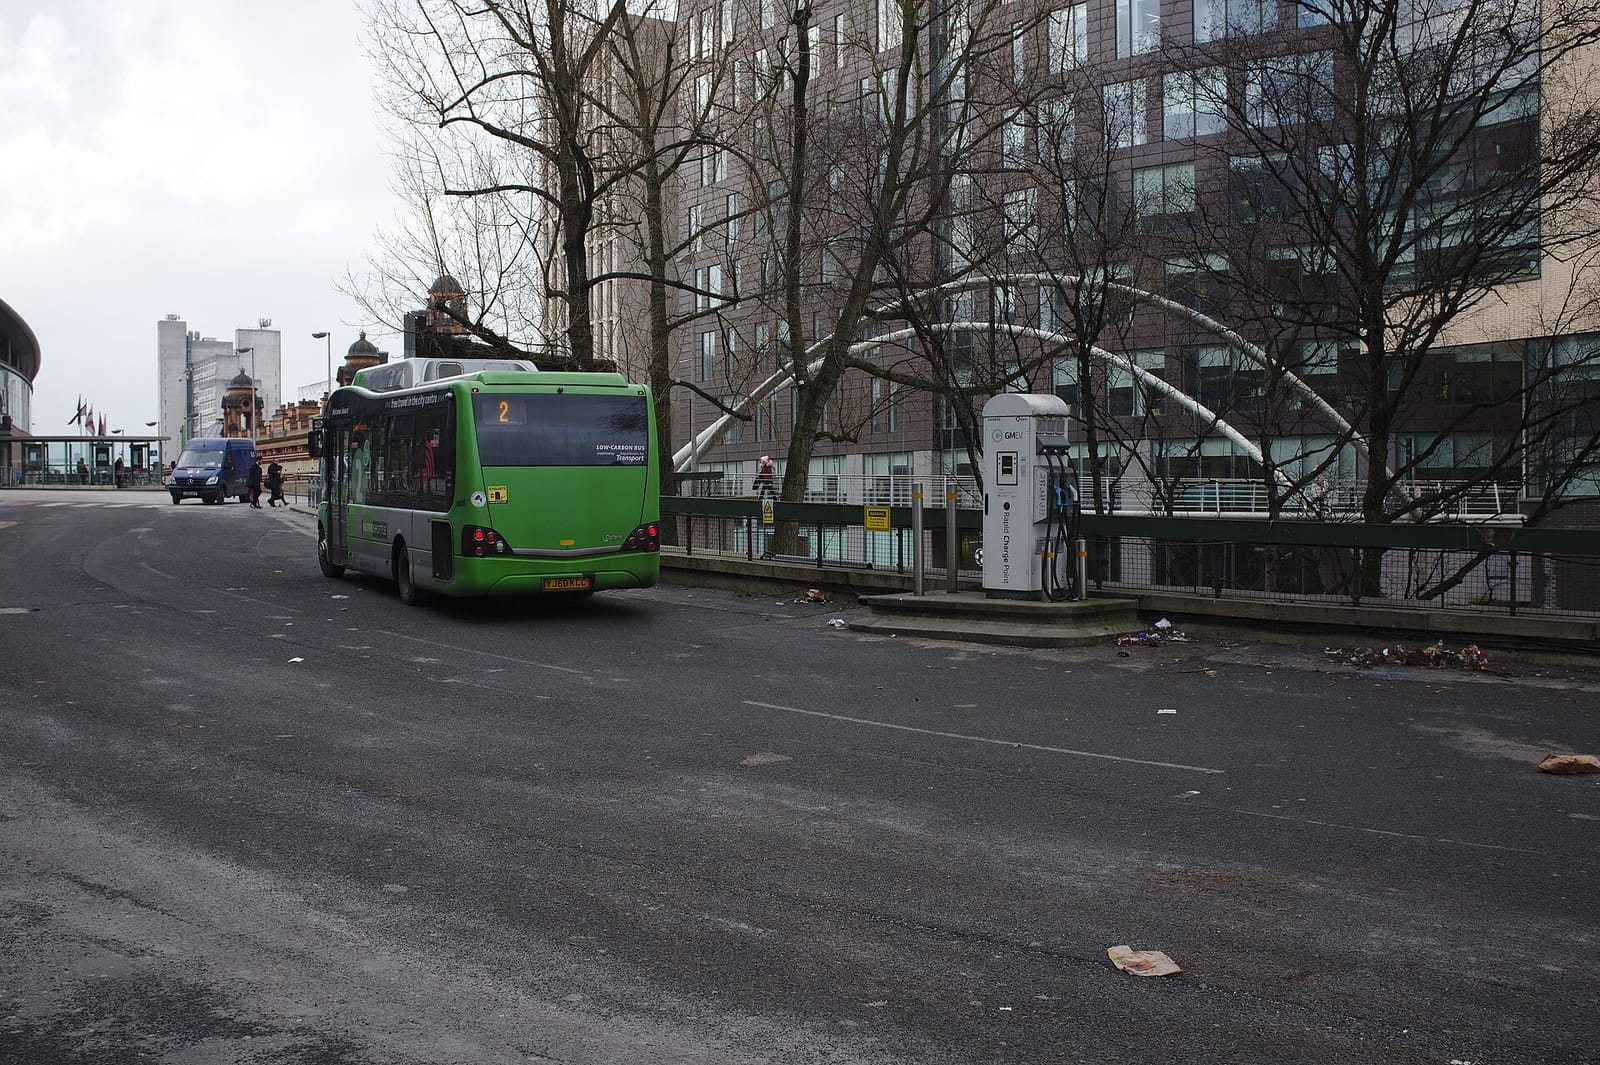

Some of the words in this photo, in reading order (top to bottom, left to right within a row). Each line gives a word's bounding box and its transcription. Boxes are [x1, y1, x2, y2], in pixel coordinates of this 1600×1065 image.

[499, 400, 509, 422] 2
[616, 454, 645, 463] Transport
[1002, 535, 1010, 563] Charge
